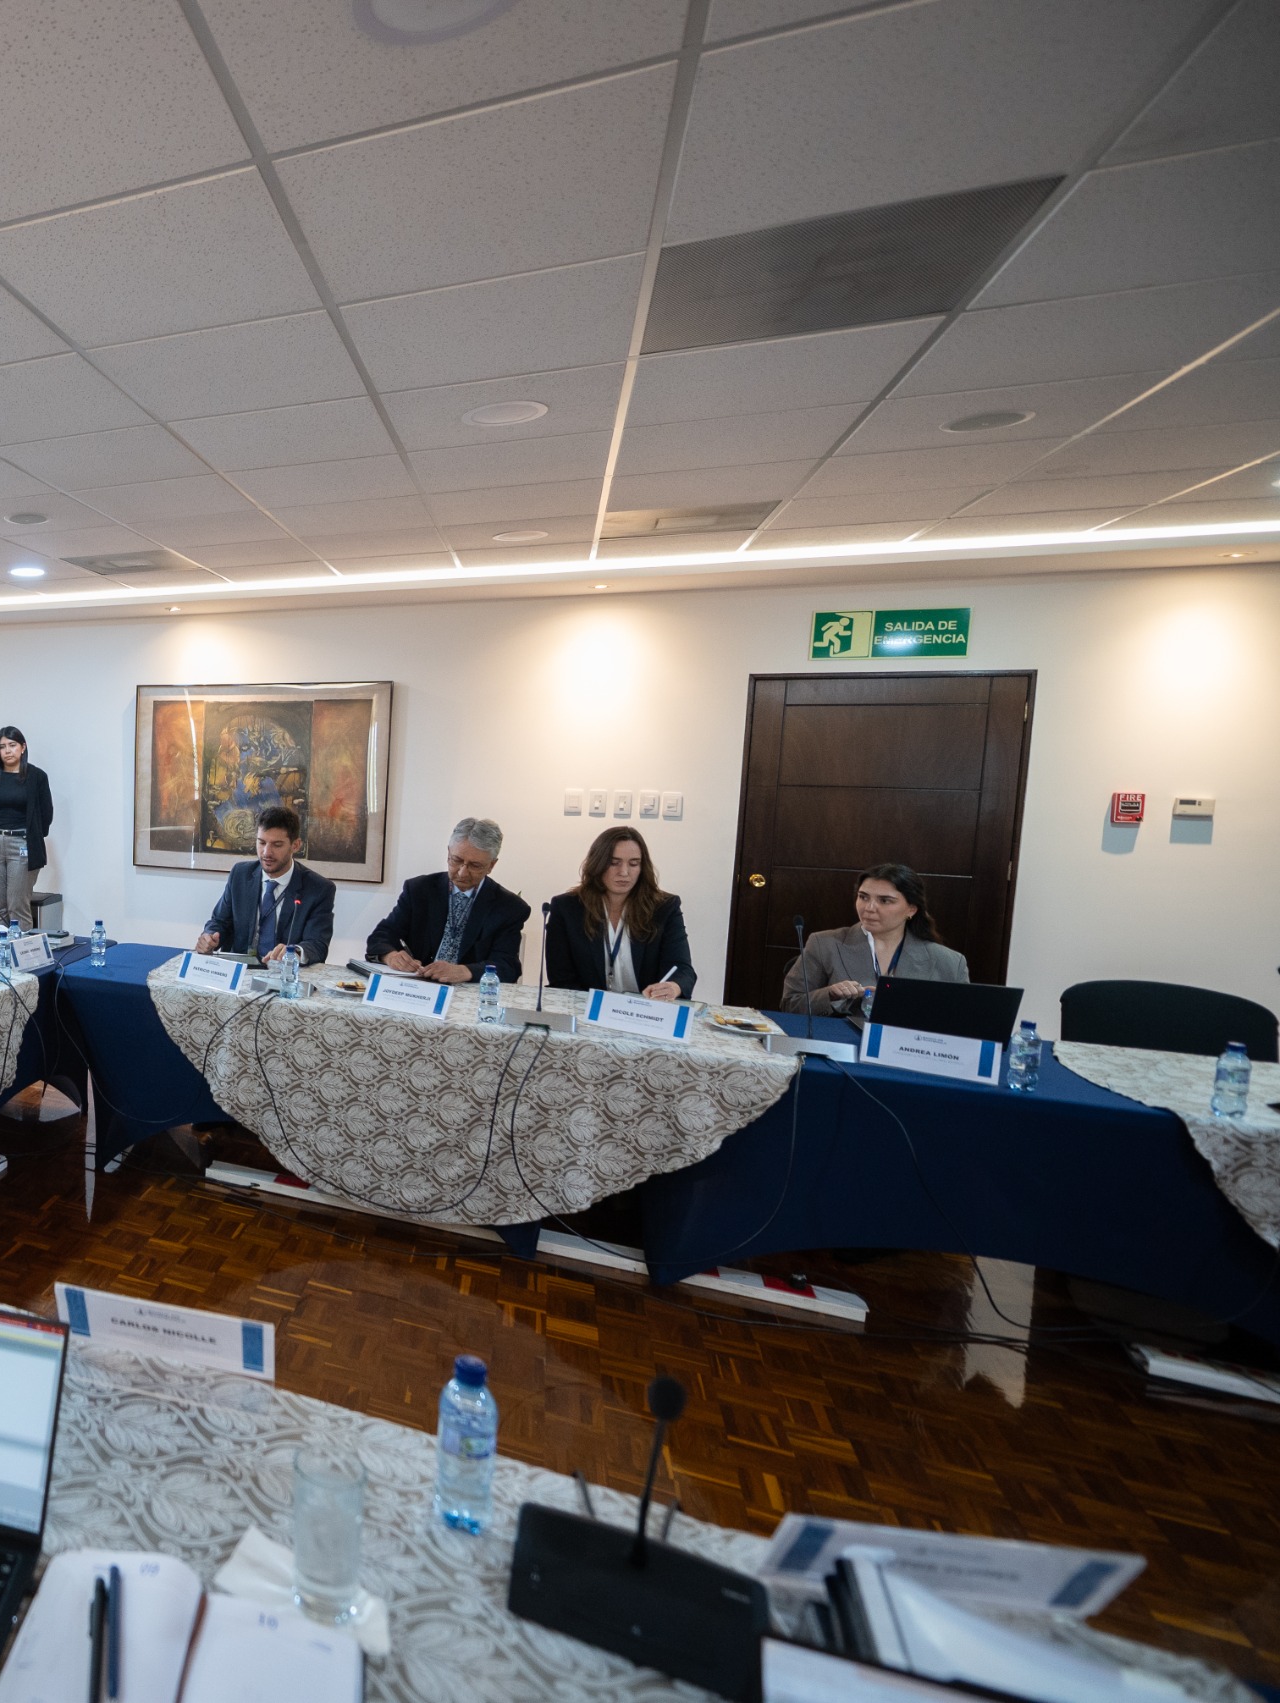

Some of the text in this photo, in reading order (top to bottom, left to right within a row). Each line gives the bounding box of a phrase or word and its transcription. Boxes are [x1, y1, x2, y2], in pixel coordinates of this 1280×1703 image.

[884, 620, 958, 632] SALIDA DE
[611, 1008, 664, 1022] NICOLE SCHMIDT
[899, 1046, 931, 1056] ANDREA
[933, 1051, 960, 1061] LIMÓN
[111, 1316, 217, 1345] CARLOS NICOLLE
